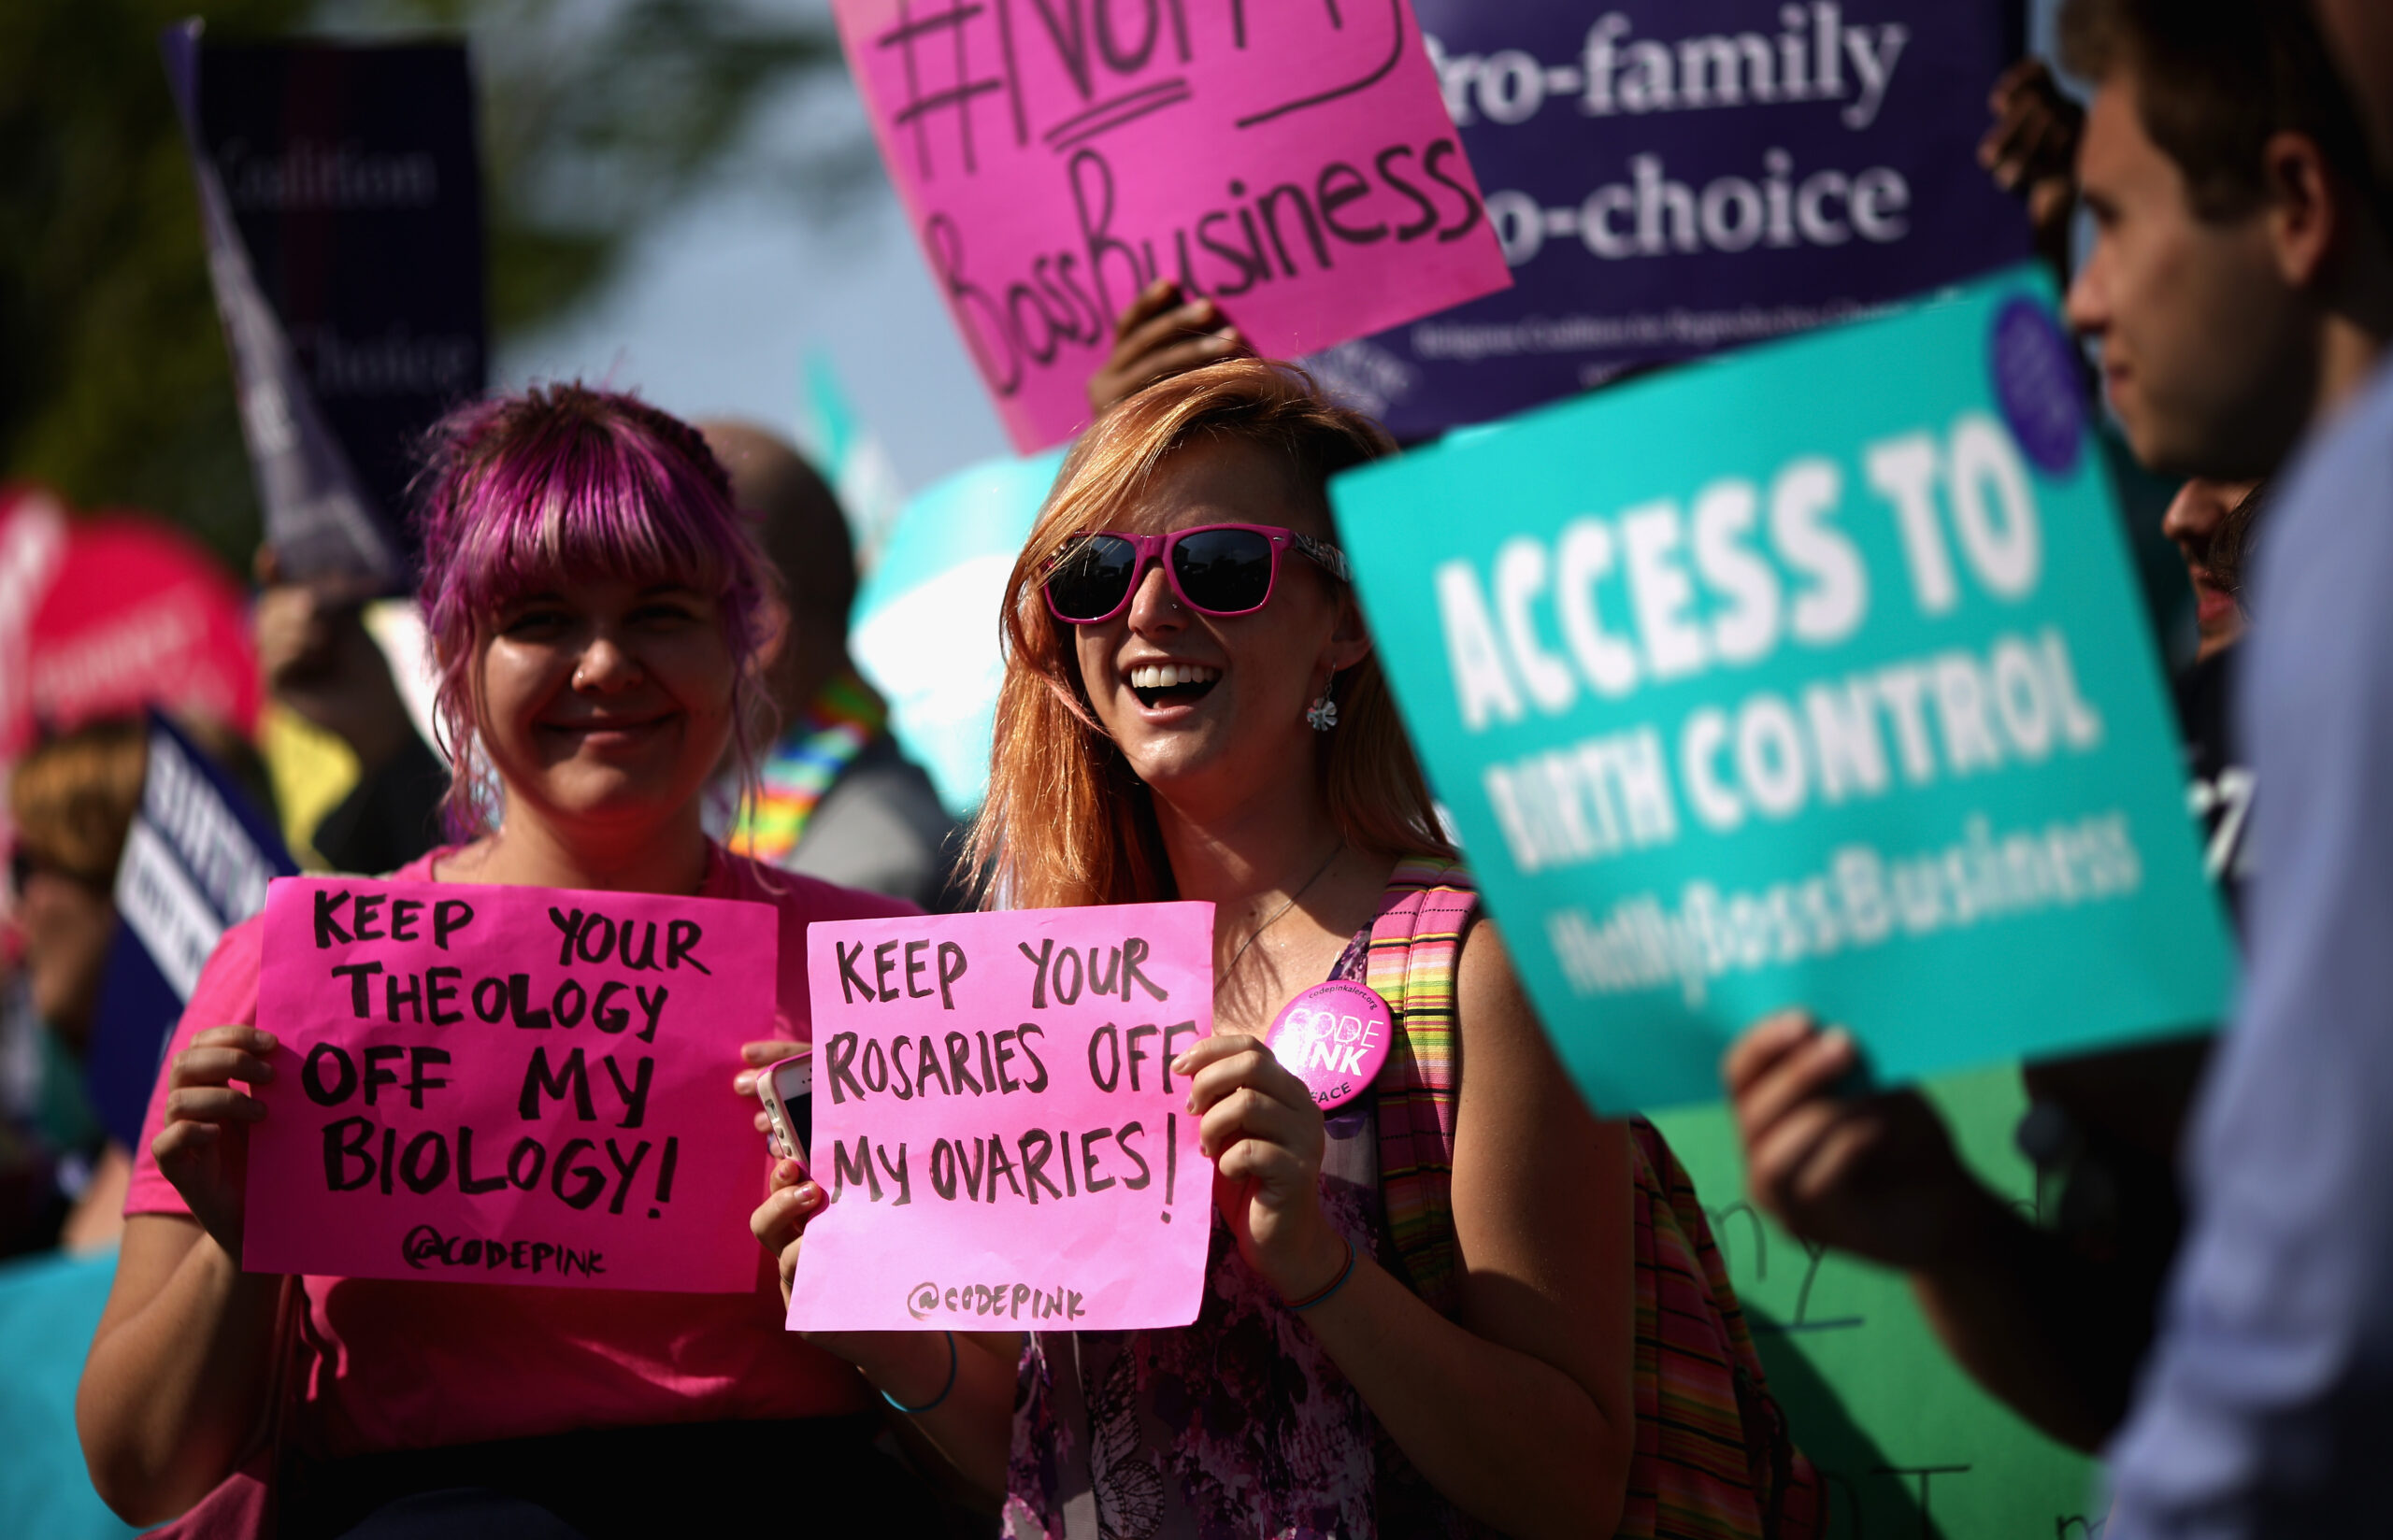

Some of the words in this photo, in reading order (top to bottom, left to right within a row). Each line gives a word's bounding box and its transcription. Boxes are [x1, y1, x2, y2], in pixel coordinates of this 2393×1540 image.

[1421, 0, 1910, 131] ro-family
[1481, 146, 1911, 268] o-choice
[924, 137, 1483, 396] BossBusiness
[1436, 458, 1870, 733] ACCESS
[1863, 411, 2045, 617] TO
[1483, 721, 1680, 875] BIRTH
[1678, 624, 2105, 834] CONTROL
[313, 889, 475, 950] KEEP
[548, 905, 712, 976] YOUR
[836, 937, 968, 1010] KEEP
[1017, 936, 1169, 1009] YOUR
[330, 960, 669, 1044] THEOLOGY
[1309, 984, 1378, 1011] codepinkalert.org
[300, 1041, 452, 1110] OFF
[517, 1045, 655, 1129] MY
[824, 1021, 1050, 1105] ROSARIES
[1087, 1020, 1200, 1095] OFF
[321, 1115, 679, 1220] BIOLOGY!
[830, 1134, 912, 1207] MY
[928, 1111, 1178, 1224] OVARIES!
[401, 1223, 607, 1276] @CODEPINK
[907, 1280, 1087, 1322] @CODEPINK
